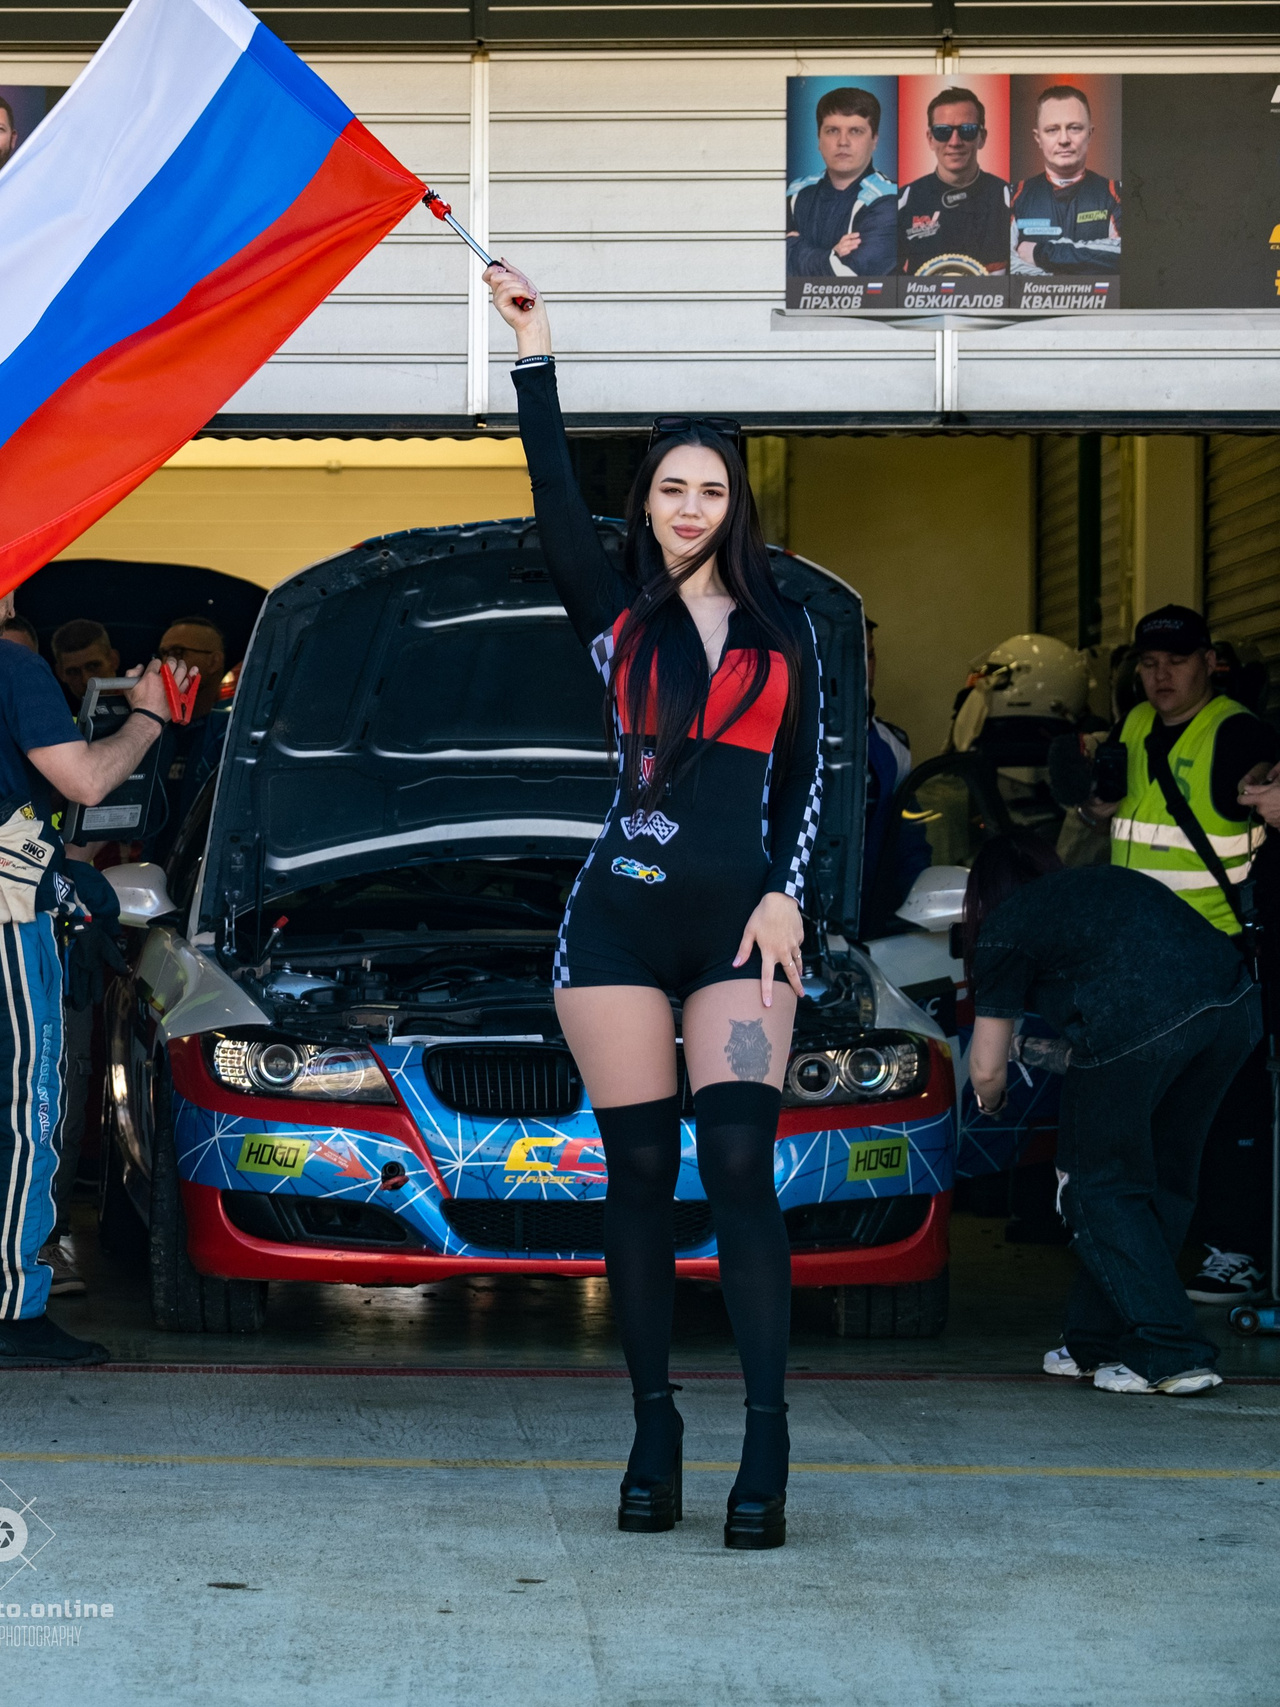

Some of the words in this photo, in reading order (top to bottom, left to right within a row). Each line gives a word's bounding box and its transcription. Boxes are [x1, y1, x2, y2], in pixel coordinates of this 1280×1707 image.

[803, 283, 864, 295] Всеволод
[906, 282, 936, 293] Илья
[1023, 282, 1092, 293] Константин
[800, 296, 862, 309] ПРАХОВ
[904, 295, 1004, 308] ОБЖИГАЛОВ
[1020, 295, 1107, 309] КВАШНИН
[22, 842, 46, 860] OMP
[245, 1142, 300, 1168] HOGO
[854, 1146, 902, 1173] HOGO
[504, 1175, 575, 1184] CLASSIC
